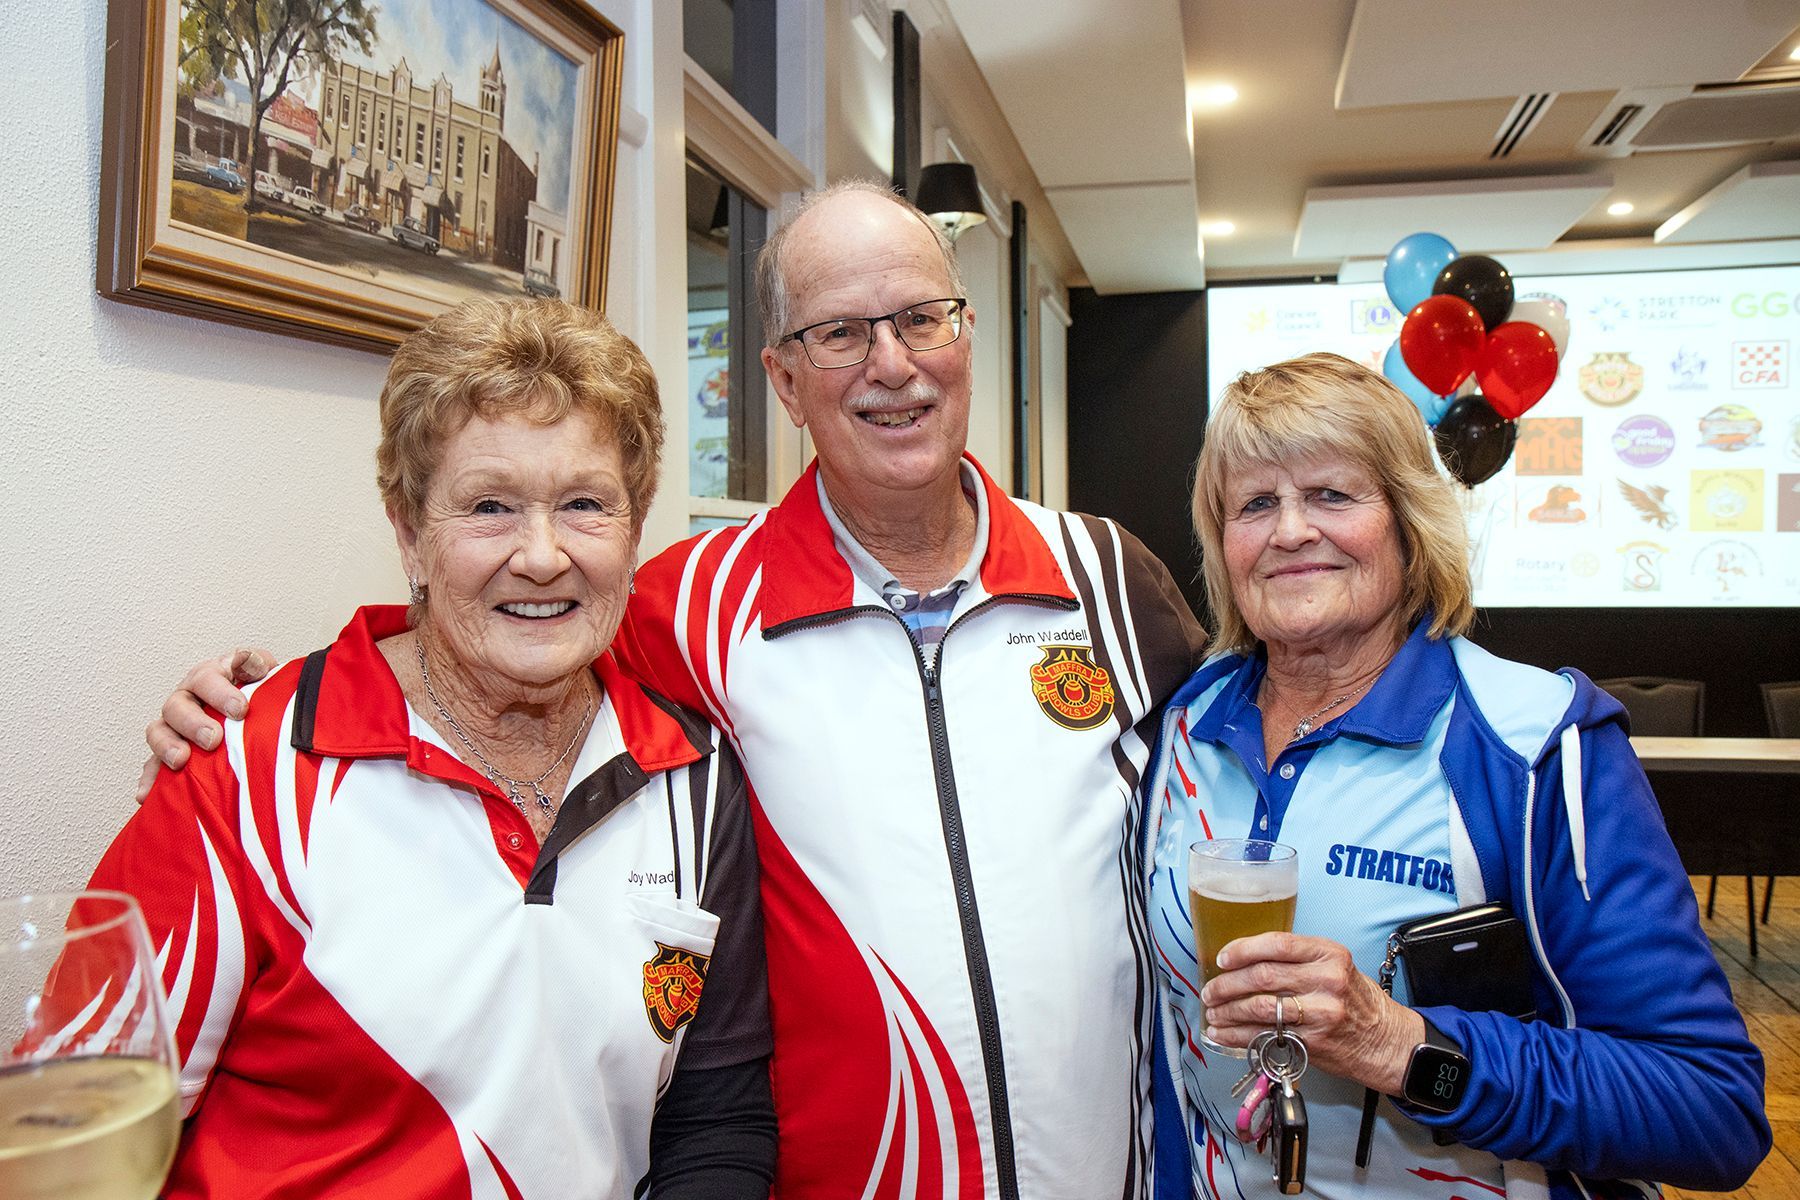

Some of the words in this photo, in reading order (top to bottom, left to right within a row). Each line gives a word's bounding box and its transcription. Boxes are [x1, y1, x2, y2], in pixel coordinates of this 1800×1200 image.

[1638, 296, 1721, 307] STRETTON
[1638, 310, 1679, 320] PARK
[1739, 370, 1781, 384] CFA
[1515, 557, 1565, 572] Rotary
[1006, 632, 1036, 645] John
[1037, 628, 1089, 642] Waddell
[1052, 662, 1088, 676] MAFFRA
[1049, 692, 1081, 717] BOWLS
[1083, 693, 1101, 715] CLUB
[627, 870, 644, 886] Joy
